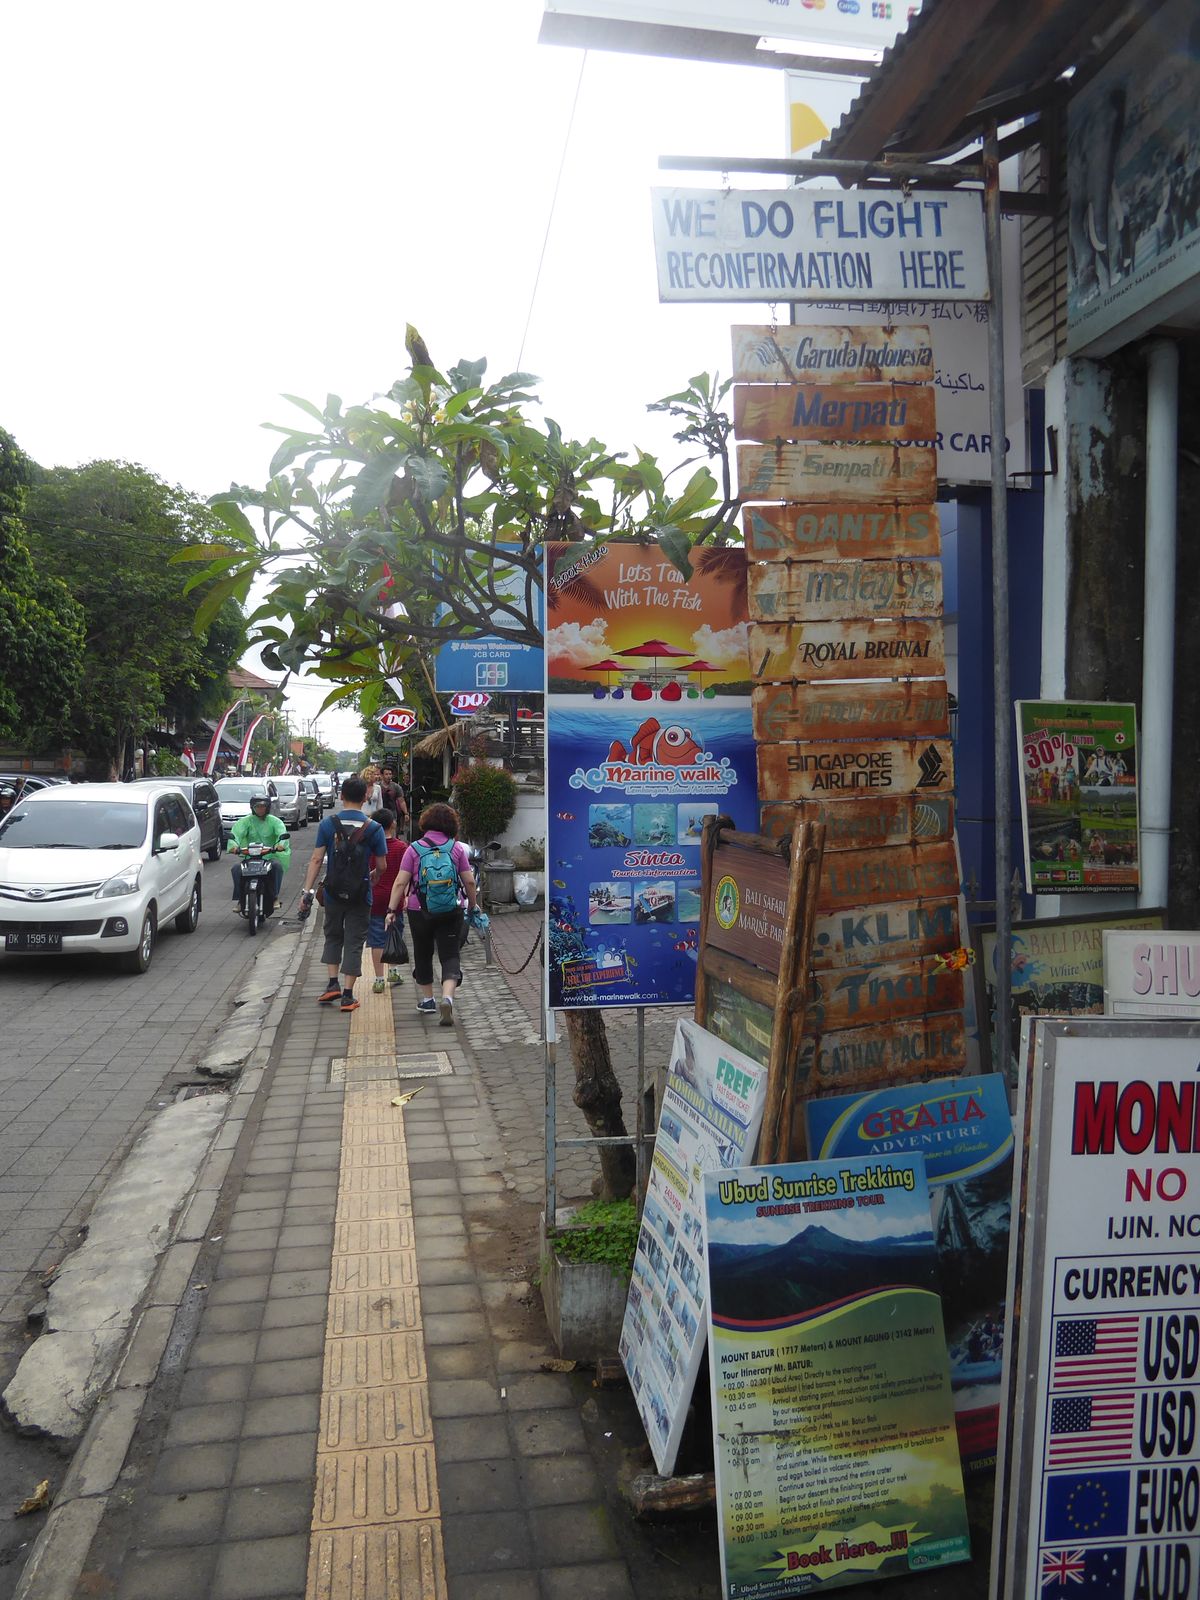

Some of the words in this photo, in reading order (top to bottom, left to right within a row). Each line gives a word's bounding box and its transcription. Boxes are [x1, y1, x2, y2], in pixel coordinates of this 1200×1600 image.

[663, 199, 716, 237] WE
[741, 201, 794, 238] DO
[814, 200, 948, 239] FLIGHT
[667, 250, 873, 289] RECONFIRMATION
[900, 249, 966, 289] HERE
[793, 391, 908, 434] Merpati
[801, 454, 885, 482] Sempati
[795, 512, 929, 543] QANTAS
[581, 544, 609, 569] Here
[618, 563, 651, 584] Lets
[805, 563, 936, 610] malaysia
[604, 589, 640, 610] With
[643, 586, 669, 608] The
[673, 590, 703, 611] Fish
[799, 641, 858, 668] ROYAL
[864, 640, 931, 660] BRUNAI
[478, 671, 505, 679] JCB
[787, 752, 892, 772] SINGAPORE
[1023, 731, 1075, 770] 30%
[681, 767, 721, 782] walk
[812, 770, 892, 791] AIRLINES
[624, 850, 685, 867] Sinta
[744, 888, 761, 906] BALI
[763, 894, 787, 918] SAFARI
[762, 910, 768, 921] &
[9, 934, 19, 944] DK
[27, 934, 46, 944] 1595
[738, 913, 769, 937] MARINE
[769, 924, 785, 945] PAR
[842, 904, 955, 948] KLM
[1030, 930, 1069, 955] BALI
[1050, 963, 1080, 979] White
[1081, 959, 1103, 973] Wat
[836, 973, 938, 1014] Thai
[816, 1040, 886, 1075] CATHAY
[892, 1027, 961, 1062] PACIFIC
[863, 1095, 987, 1138] GRAHA
[1071, 1080, 1200, 1155] MON
[870, 1125, 981, 1154] ADVENTURE
[719, 1176, 769, 1205] Ubud
[772, 1173, 836, 1200] Sunrise
[839, 1165, 915, 1193] Trekking
[1125, 1168, 1186, 1202] NO
[756, 1204, 801, 1217] SUNRISE
[802, 1198, 855, 1214] TREKKING
[856, 1194, 885, 1208] TOUR
[1108, 1216, 1159, 1239] IJIN.
[721, 1352, 749, 1364] MOUNT
[751, 1349, 775, 1360] BATUR
[782, 1345, 799, 1356] 1717
[835, 1336, 863, 1348] MOUNT
[864, 1332, 890, 1343] AGUNG
[896, 1328, 912, 1339] 3142
[1143, 1314, 1200, 1382] USD
[722, 1370, 739, 1380] Tour
[741, 1366, 772, 1378] Itinerary
[788, 1359, 813, 1370] BATUR:
[1139, 1390, 1196, 1458] USD
[777, 1473, 788, 1482] and
[779, 1483, 804, 1493] Continue
[805, 1480, 815, 1488] our
[816, 1477, 827, 1486] trek
[849, 1471, 859, 1480] the
[779, 1495, 796, 1505] Begin
[796, 1493, 806, 1501] our
[807, 1489, 829, 1499] descent
[829, 1486, 839, 1494] the
[840, 1483, 864, 1492] finishing
[864, 1480, 879, 1490] point
[1134, 1465, 1200, 1534] EURO
[787, 1544, 833, 1571] Book
[1132, 1542, 1191, 1600] AUD
[740, 1583, 758, 1594] Ubud
[760, 1580, 783, 1590] Sunrise
[784, 1575, 811, 1586] Trekking
